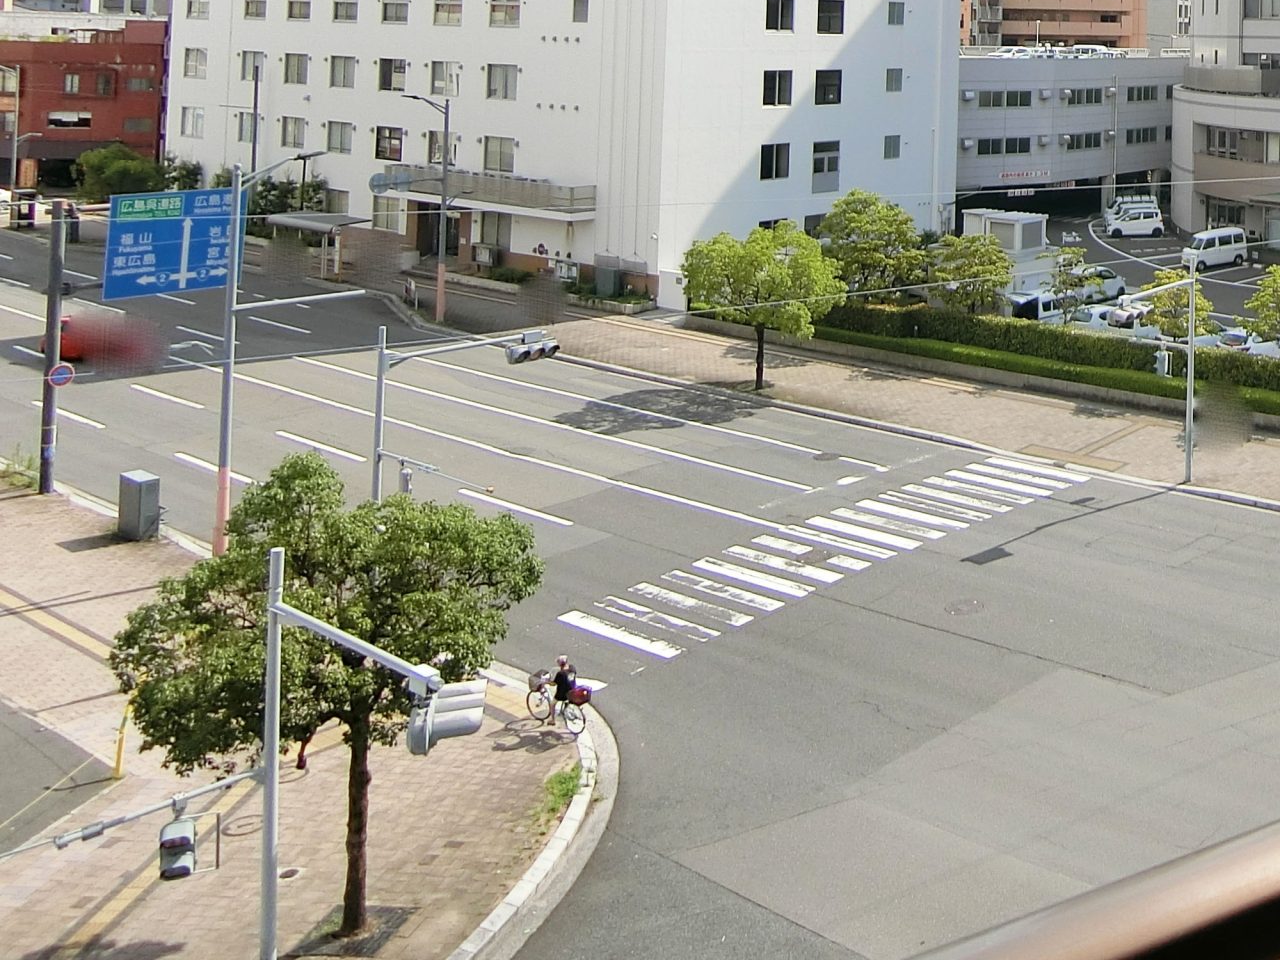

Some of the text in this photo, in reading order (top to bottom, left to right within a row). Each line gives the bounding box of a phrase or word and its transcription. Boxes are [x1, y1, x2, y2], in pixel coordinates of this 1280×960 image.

[121, 197, 182, 213] 広島呉道路
[120, 232, 153, 246] 福山
[113, 254, 156, 267] 東広島
